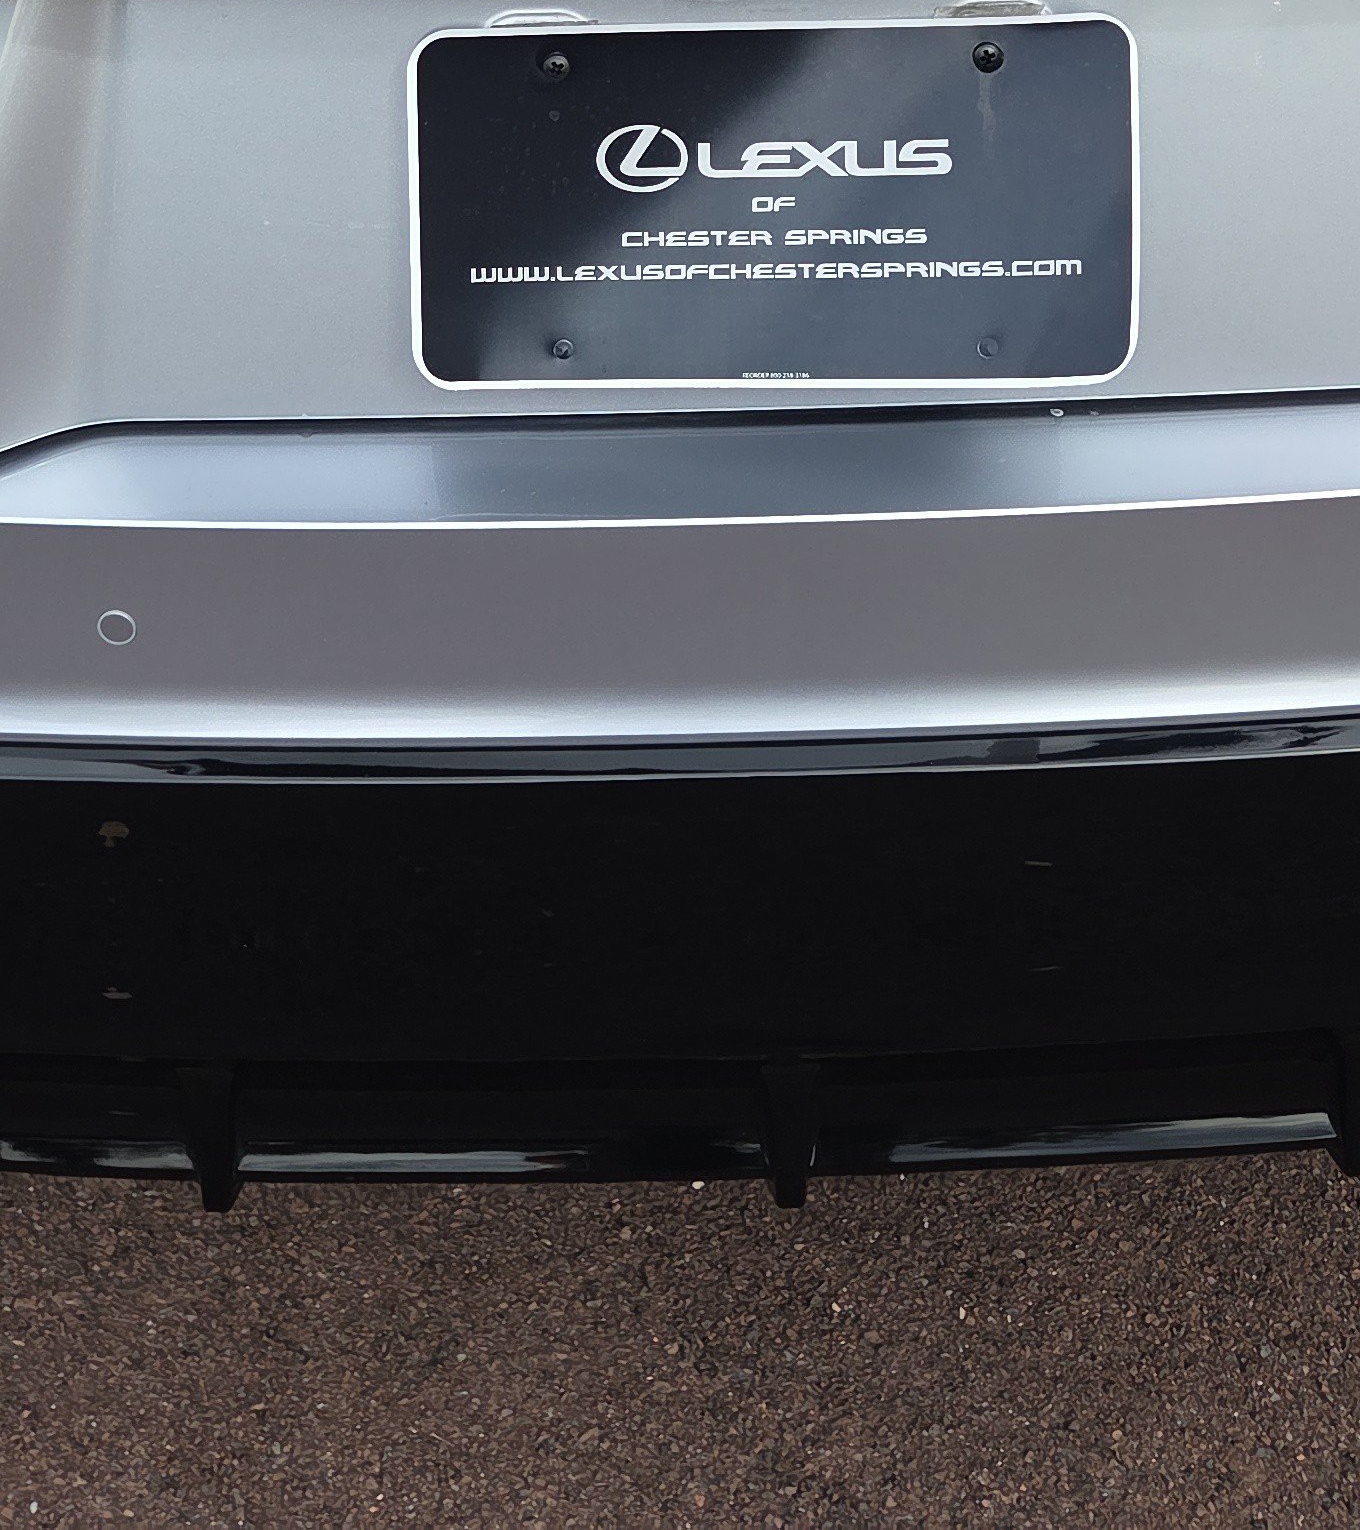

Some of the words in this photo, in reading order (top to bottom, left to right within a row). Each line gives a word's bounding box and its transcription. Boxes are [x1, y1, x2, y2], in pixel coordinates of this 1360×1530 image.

[697, 138, 953, 179] LEXUS
[751, 196, 796, 213] OF
[621, 230, 773, 248] CHESTER
[784, 228, 928, 246] SPRINGS
[470, 259, 1083, 284] WWW.LEXUSOFCHESTERSPRINGS.COM
